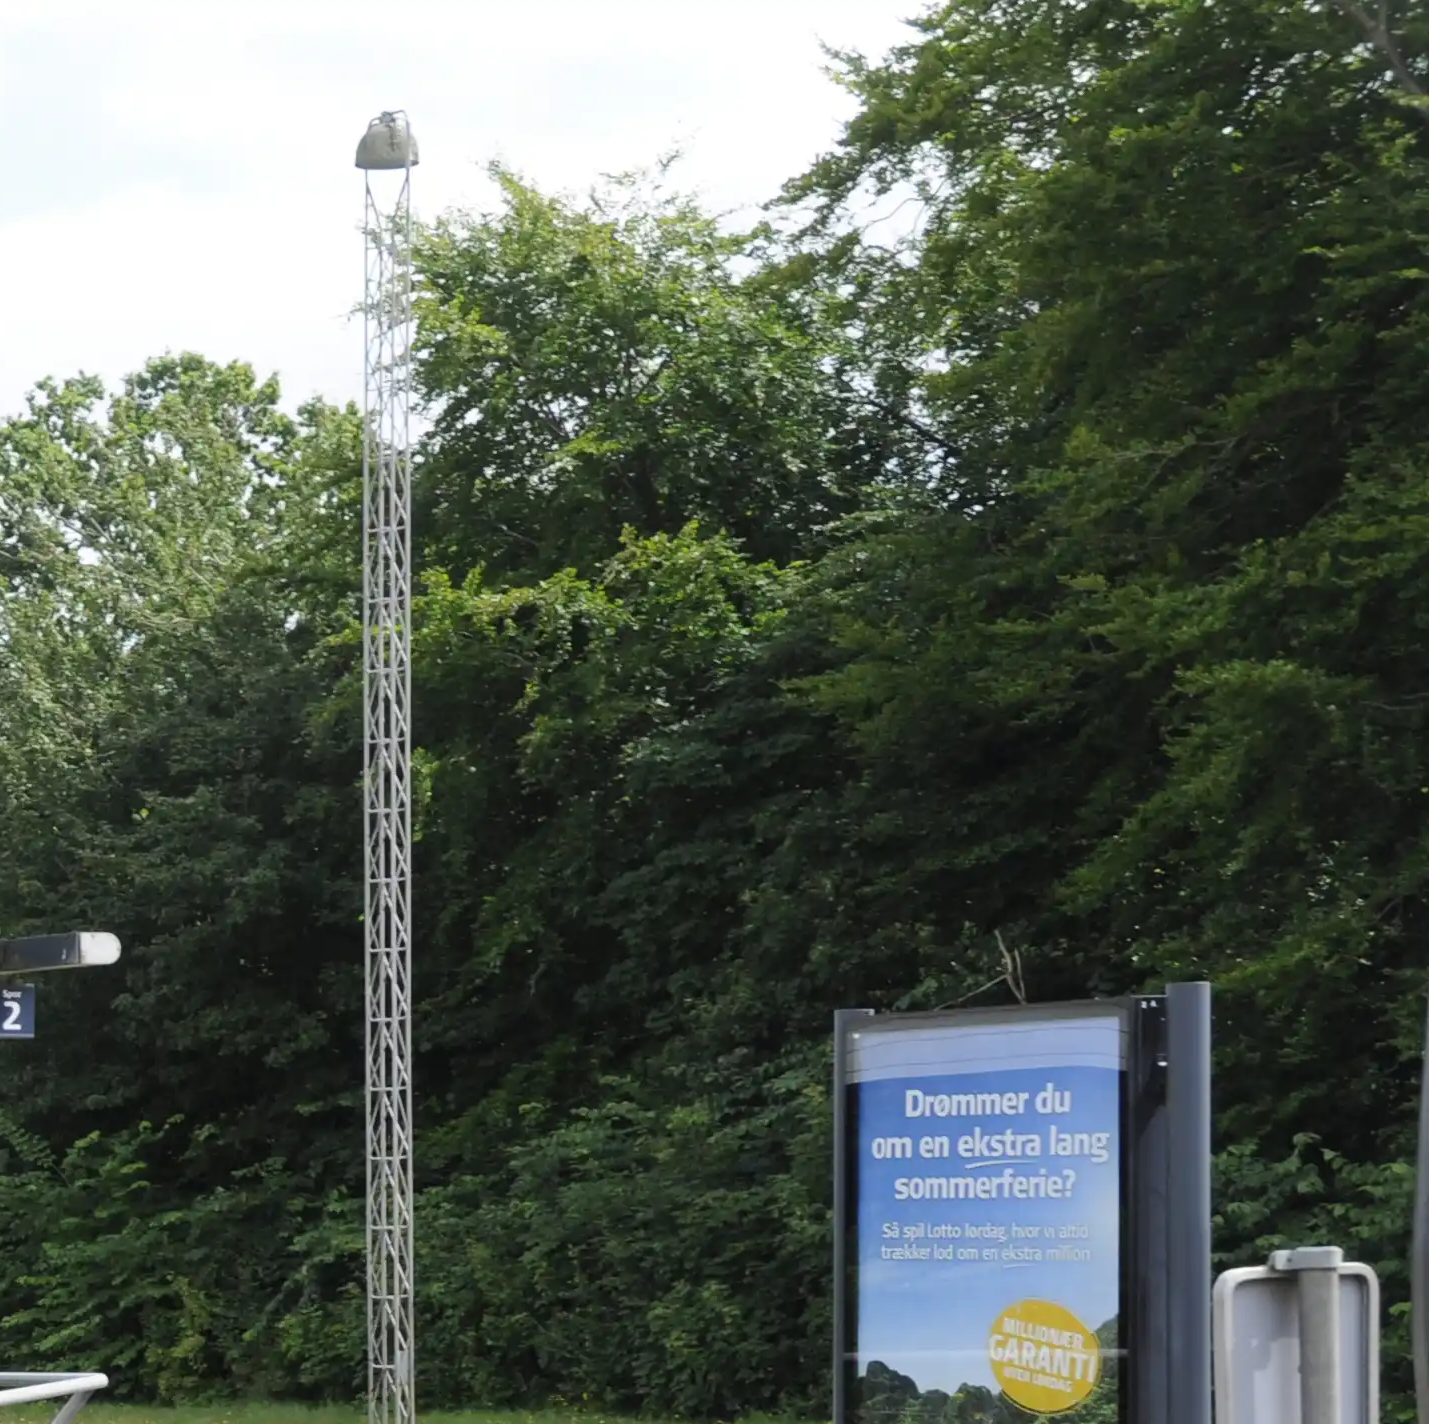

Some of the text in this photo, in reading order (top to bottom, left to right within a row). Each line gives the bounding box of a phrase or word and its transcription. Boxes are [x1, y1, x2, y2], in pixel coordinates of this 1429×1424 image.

[2, 1000, 21, 1030] 2
[905, 1083, 1071, 1117] Drømmer du
[872, 1125, 1110, 1162] om en ekstra lang
[894, 1168, 1076, 1200] sommerferie?
[882, 1222, 900, 1238] Så
[928, 1223, 961, 1239] Lotto
[1011, 1223, 1040, 1238] hvor
[934, 1244, 953, 1260] lod
[957, 1248, 979, 1260] om
[983, 1248, 998, 1260] en
[1002, 1244, 1042, 1260] ekstra
[989, 1334, 1095, 1383] GARANTI
